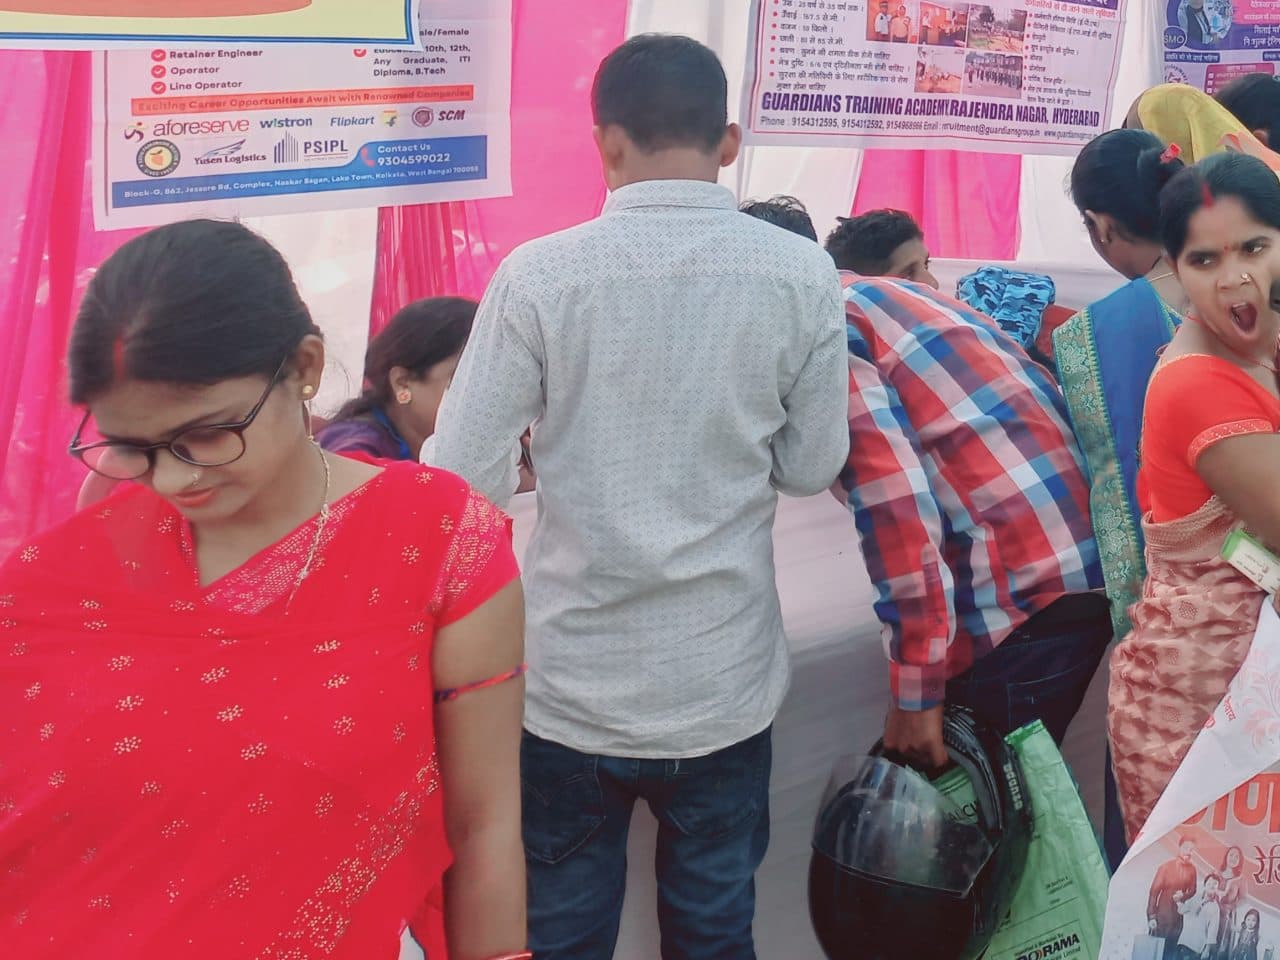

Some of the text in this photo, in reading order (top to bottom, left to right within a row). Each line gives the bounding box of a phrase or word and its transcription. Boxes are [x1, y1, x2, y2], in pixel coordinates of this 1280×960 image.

[169, 49, 263, 59] Retainer Engineer
[425, 44, 447, 53] 10th,
[450, 44, 471, 53] 12th,
[373, 55, 471, 67] Any Graduate, ITI
[170, 65, 220, 76] Operator
[373, 67, 446, 77] Diploma, B.Tech
[169, 80, 242, 91] Line Operator
[188, 100, 227, 110] Career
[230, 96, 304, 108] Opportunities
[306, 95, 336, 104] Await
[339, 94, 361, 103] with
[364, 92, 414, 102] Renowned
[761, 91, 842, 113] GUARDIANS
[845, 94, 903, 115] TRAINING
[950, 99, 1014, 121] RAJENDRA
[1015, 104, 1049, 124] NAGAR,
[1052, 107, 1100, 128] HYDERABAD
[438, 110, 466, 121] SCM
[760, 115, 785, 126] Phone
[153, 118, 249, 137] aforeserve
[259, 116, 312, 130] wistron
[330, 116, 375, 128] Flipkart
[304, 139, 348, 154] PSIPL
[377, 143, 431, 154] Contact Us
[194, 153, 267, 165] Yusen Logistics
[377, 153, 451, 166] 9304599022
[351, 174, 374, 182] Town,
